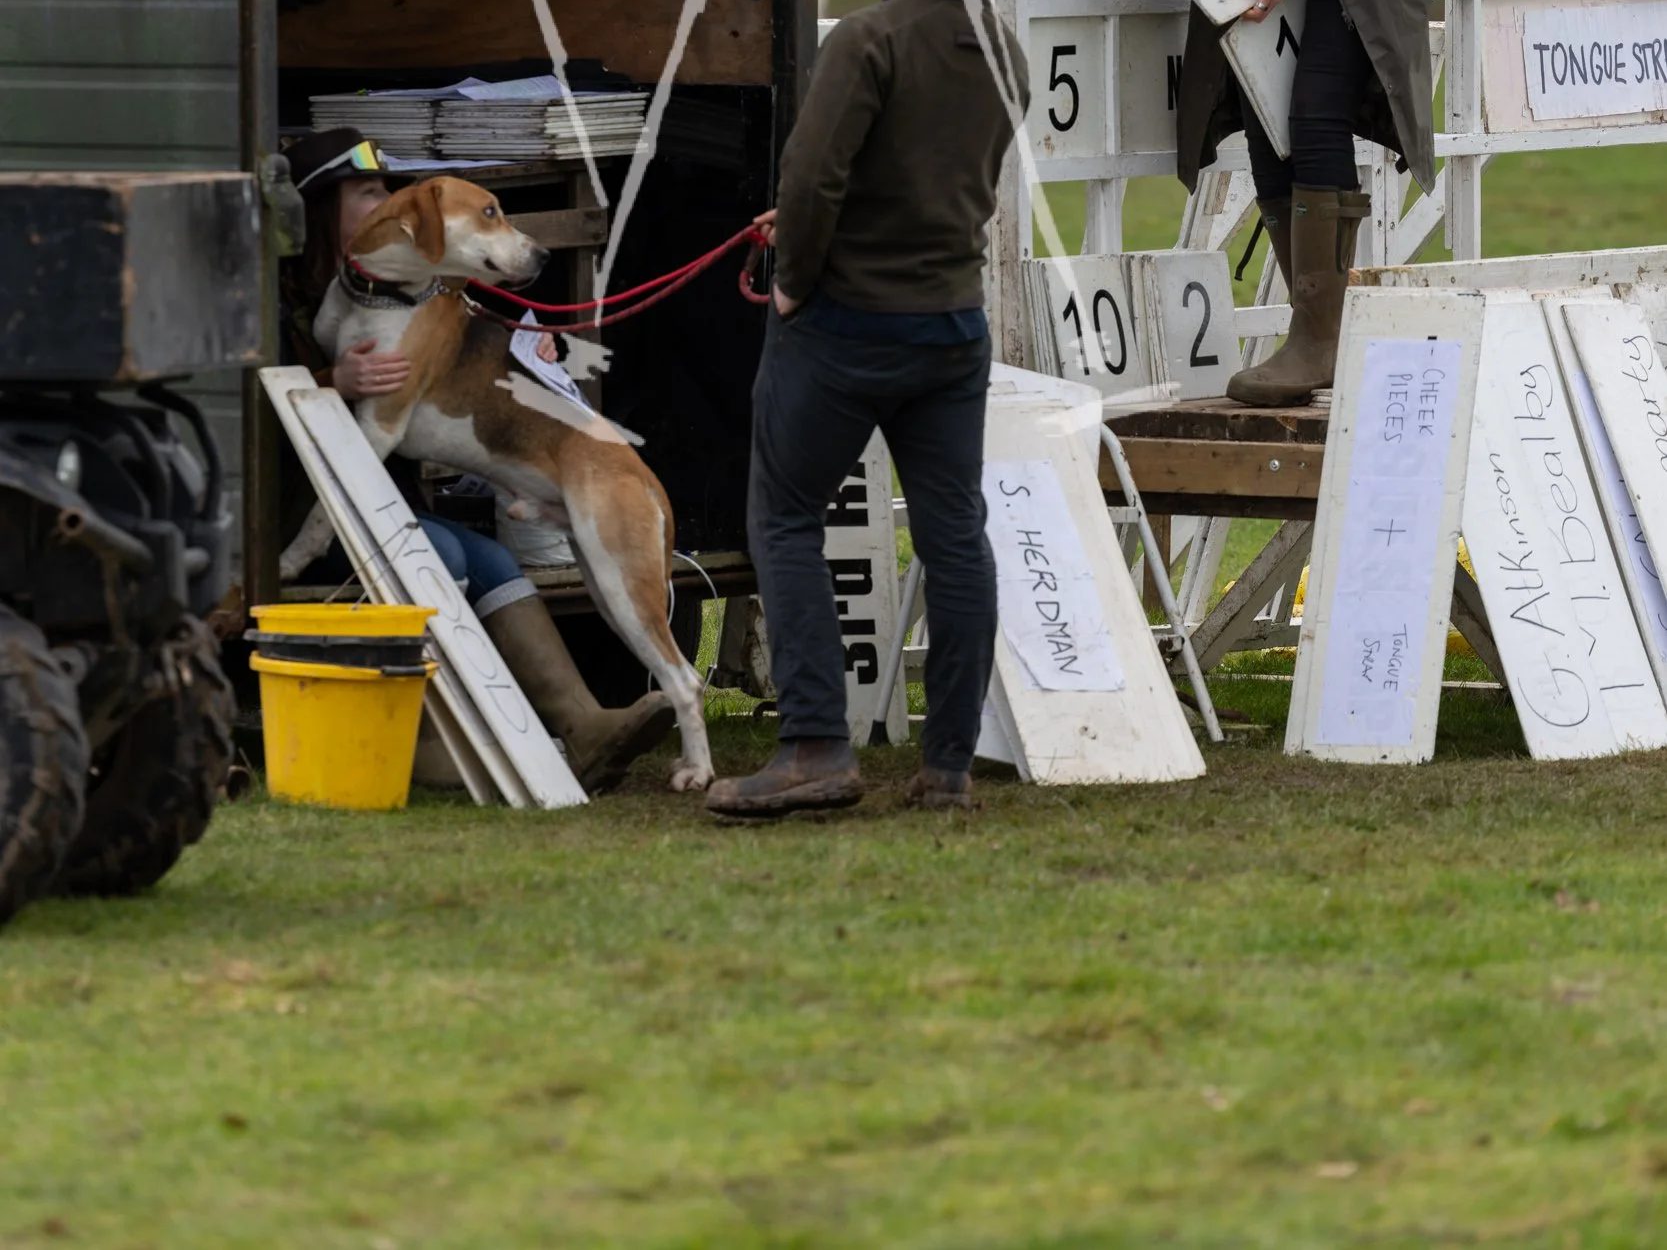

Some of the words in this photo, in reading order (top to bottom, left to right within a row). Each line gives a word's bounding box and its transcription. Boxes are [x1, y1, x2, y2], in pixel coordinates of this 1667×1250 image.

[1048, 44, 1080, 132] 5
[1533, 41, 1627, 94] TONGUE
[1632, 38, 1667, 84] STR
[1062, 289, 1127, 376] 10
[1182, 281, 1219, 368] 2
[1384, 373, 1414, 444] PIECES
[1418, 368, 1446, 437] CHEEK
[1016, 530, 1084, 675] HERDMAN
[1384, 624, 1409, 692] TONGUE
